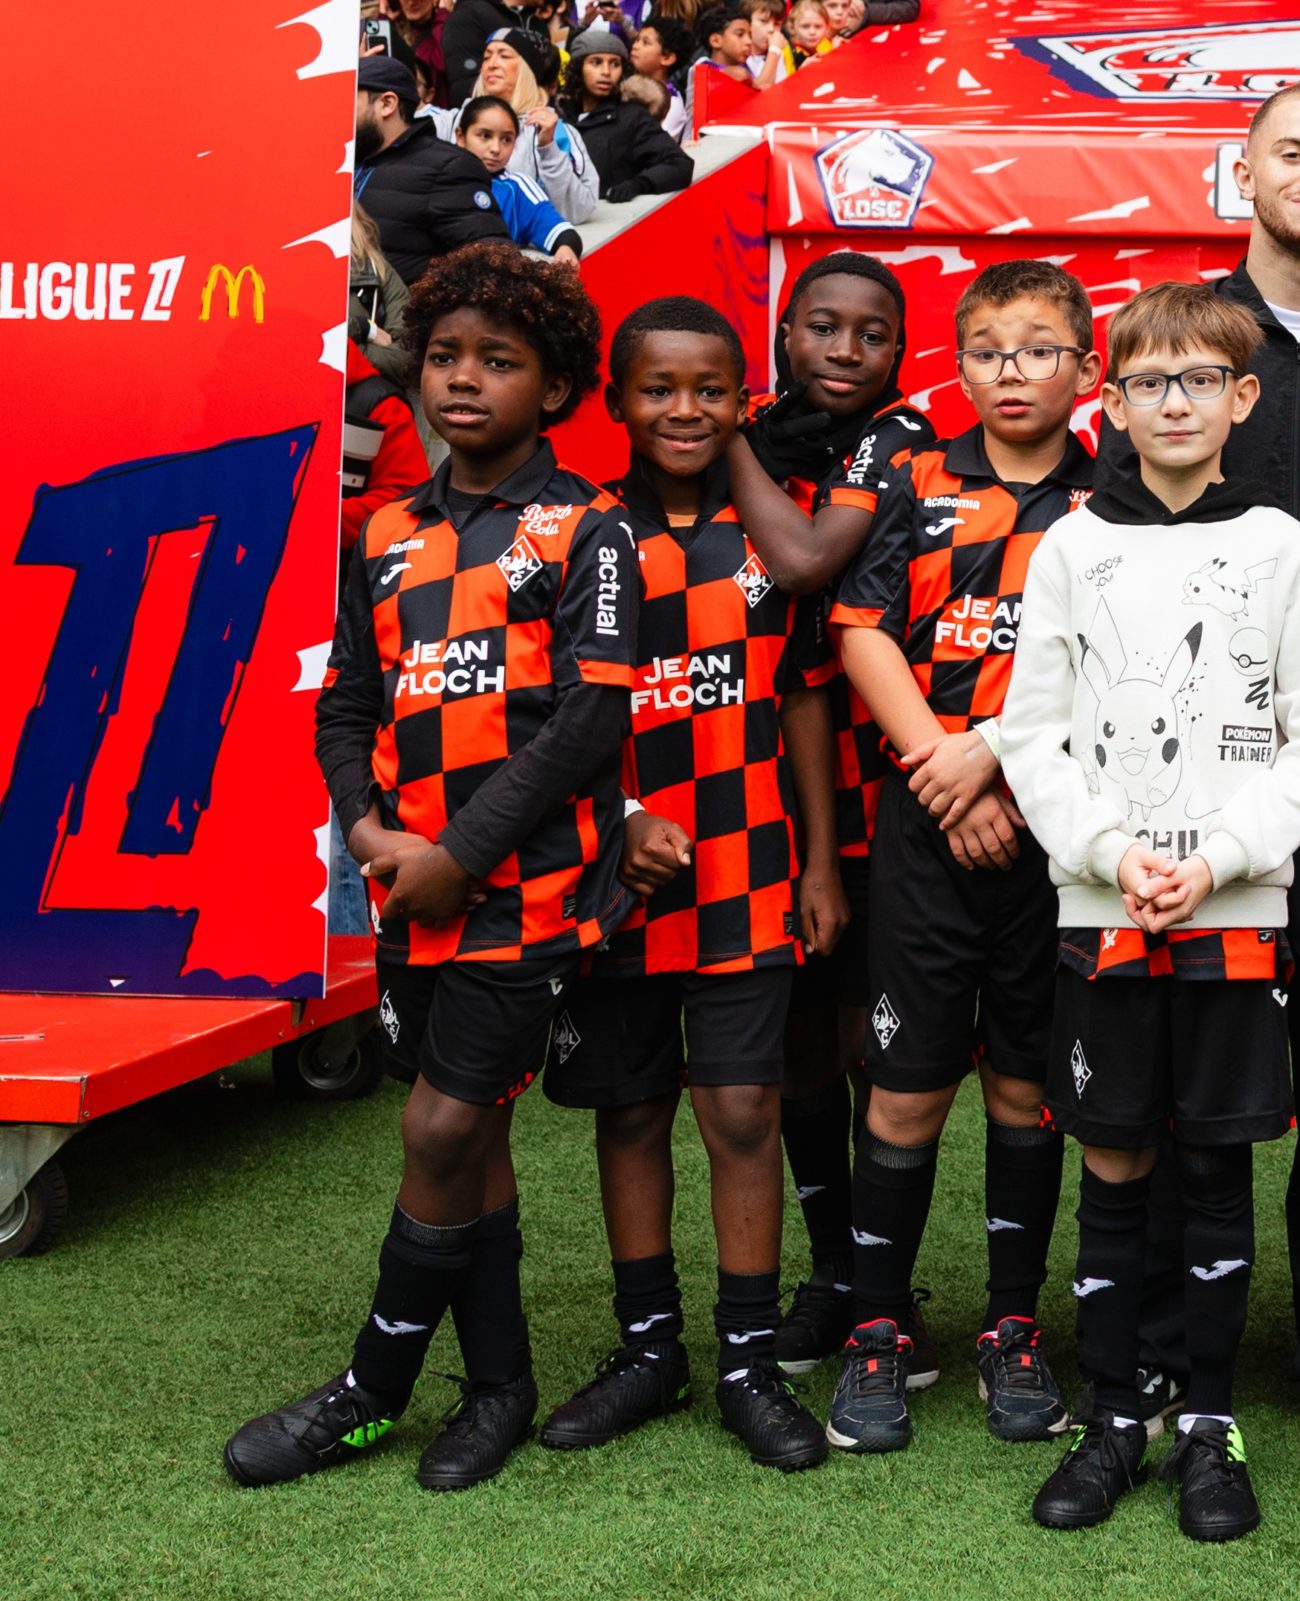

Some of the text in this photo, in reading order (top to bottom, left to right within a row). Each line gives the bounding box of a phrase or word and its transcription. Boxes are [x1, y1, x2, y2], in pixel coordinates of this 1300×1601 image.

[843, 198, 904, 219] LOSC
[0, 261, 136, 321] LIGUE
[846, 434, 877, 485] actu
[525, 520, 560, 536] Cola
[595, 546, 621, 636] actual
[404, 640, 489, 668] JEAN
[643, 654, 731, 684] JEAN
